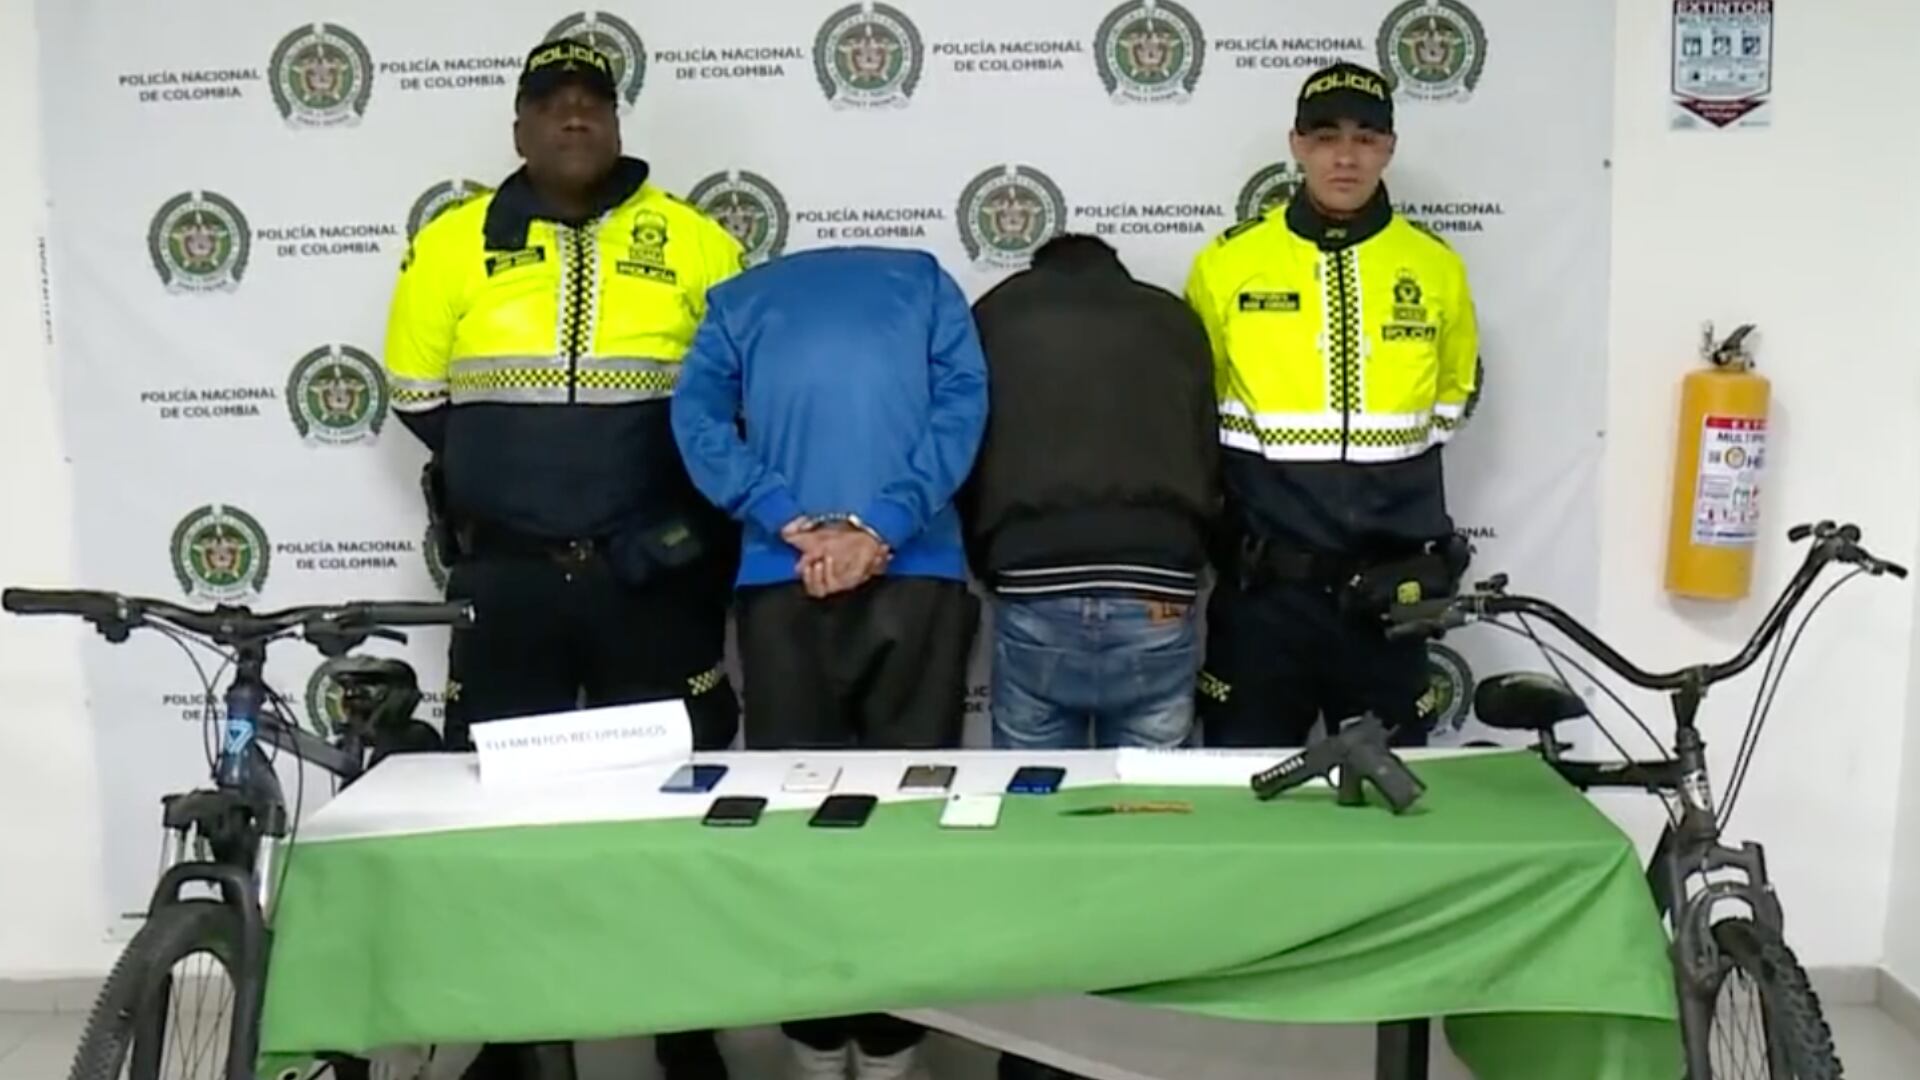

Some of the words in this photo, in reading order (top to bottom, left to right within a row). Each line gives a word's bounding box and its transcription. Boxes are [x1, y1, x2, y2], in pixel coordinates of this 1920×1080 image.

[932, 41, 997, 55] POLICÍA
[1000, 40, 1083, 53] NACIONAL
[1215, 37, 1278, 51] POLICÍA
[1282, 38, 1365, 51] NACIONAL
[654, 48, 717, 63] POLICÍA
[721, 47, 804, 60] NACIONAL
[1236, 56, 1256, 68] DE
[380, 59, 439, 73] POLICÍA
[444, 57, 521, 70] NACIONAL
[676, 67, 696, 79] DE
[700, 65, 784, 78] COLOMBIA
[954, 60, 975, 72] DE
[979, 59, 1064, 71] COLOMBIA
[119, 71, 178, 86] POLICÍA
[181, 69, 260, 83] NACIONAL
[400, 78, 420, 90] DE
[424, 74, 506, 88] COLOMBIA
[139, 90, 158, 102] DE
[162, 86, 242, 101] COLOMBIA
[796, 208, 859, 223] POLICÍA
[862, 208, 944, 221] NACIONAL
[1075, 204, 1138, 218] POLICÍA
[1142, 204, 1224, 217] NACIONAL
[1420, 203, 1502, 216] NACIONAL
[257, 226, 316, 240] POLICÍA
[320, 224, 398, 237] NACIONAL
[817, 227, 837, 239] DE
[842, 225, 925, 238] COLOMBIA
[1096, 223, 1117, 236] DE
[1120, 222, 1205, 234] COLOMBIA
[277, 244, 298, 257] DE
[301, 242, 380, 255] COLOMBIA
[141, 389, 198, 402] POLICÍA
[201, 388, 276, 401] NACIONAL
[160, 407, 179, 419] DE
[183, 404, 260, 418] COLOMBIA
[277, 541, 335, 554] POLICÍA
[338, 541, 416, 552] NACIONAL
[296, 559, 315, 570] DE
[319, 557, 398, 569] COLOMBIA
[182, 709, 201, 721] DE
